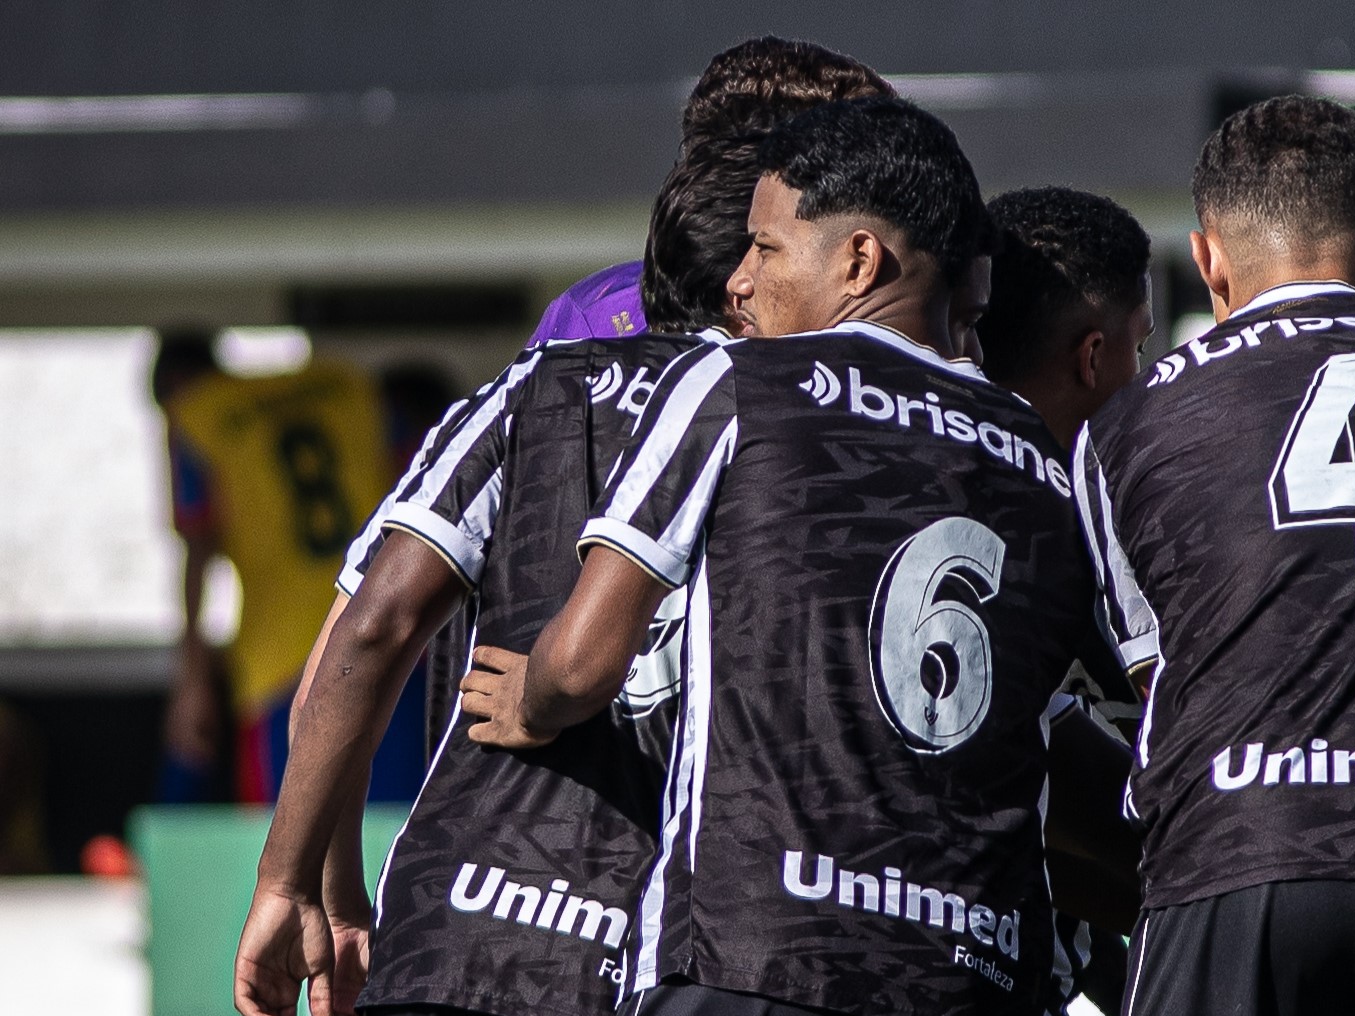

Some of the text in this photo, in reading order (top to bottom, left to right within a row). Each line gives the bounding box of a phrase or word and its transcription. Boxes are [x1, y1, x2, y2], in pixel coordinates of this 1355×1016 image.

[868, 516, 1006, 755] 6
[783, 850, 1021, 961] Unimed
[954, 944, 1015, 993] Fortaleza
